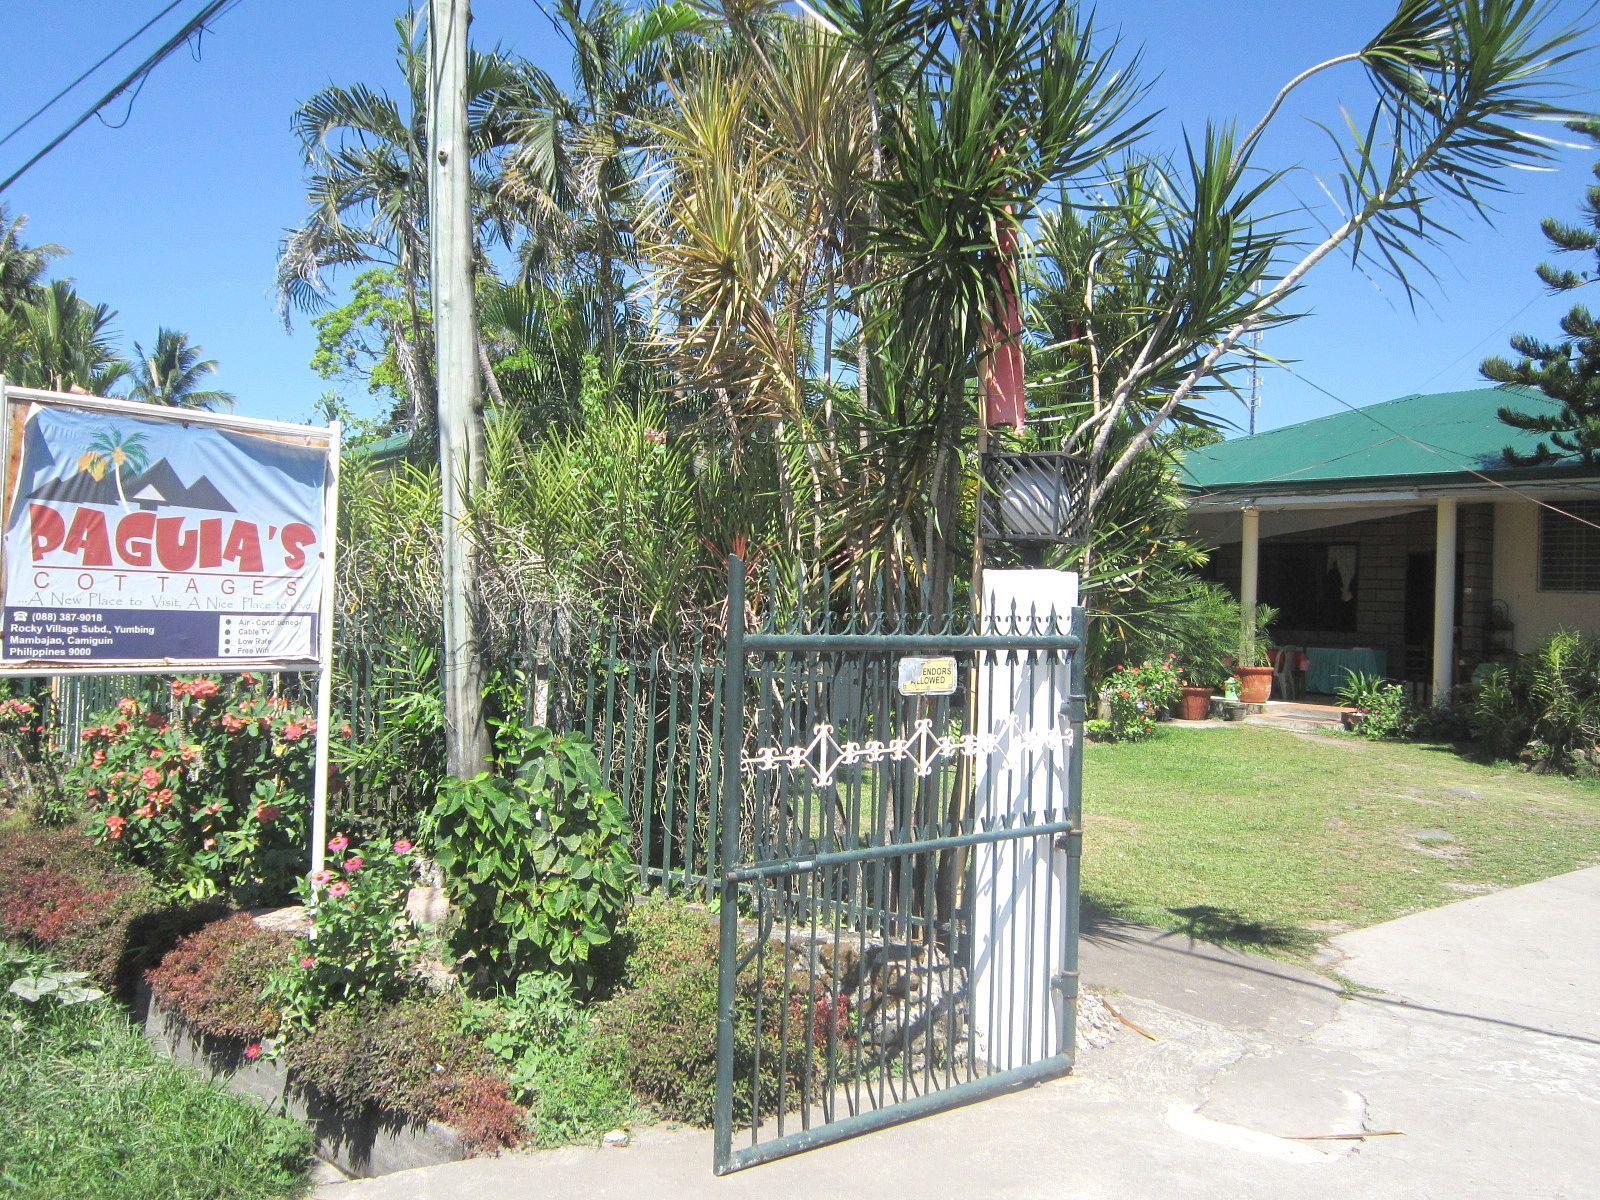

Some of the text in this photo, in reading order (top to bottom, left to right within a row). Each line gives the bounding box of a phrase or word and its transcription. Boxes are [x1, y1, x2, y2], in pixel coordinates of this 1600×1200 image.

[29, 503, 317, 572] PAGUIA'S
[34, 571, 297, 596] COTTAGES
[51, 592, 82, 606] New
[88, 592, 124, 607] Place
[129, 596, 143, 606] to
[187, 596, 201, 609] A
[206, 596, 234, 609] Nice
[242, 597, 271, 610] Place
[276, 600, 287, 609] to
[32, 612, 103, 622] (088) 387-9018
[10, 624, 155, 635] Rocky Village Subd., Yumbing
[9, 635, 113, 646] Mambajao, Camiguin
[9, 647, 91, 658] Philippines 9000
[921, 667, 952, 676] ENDORS
